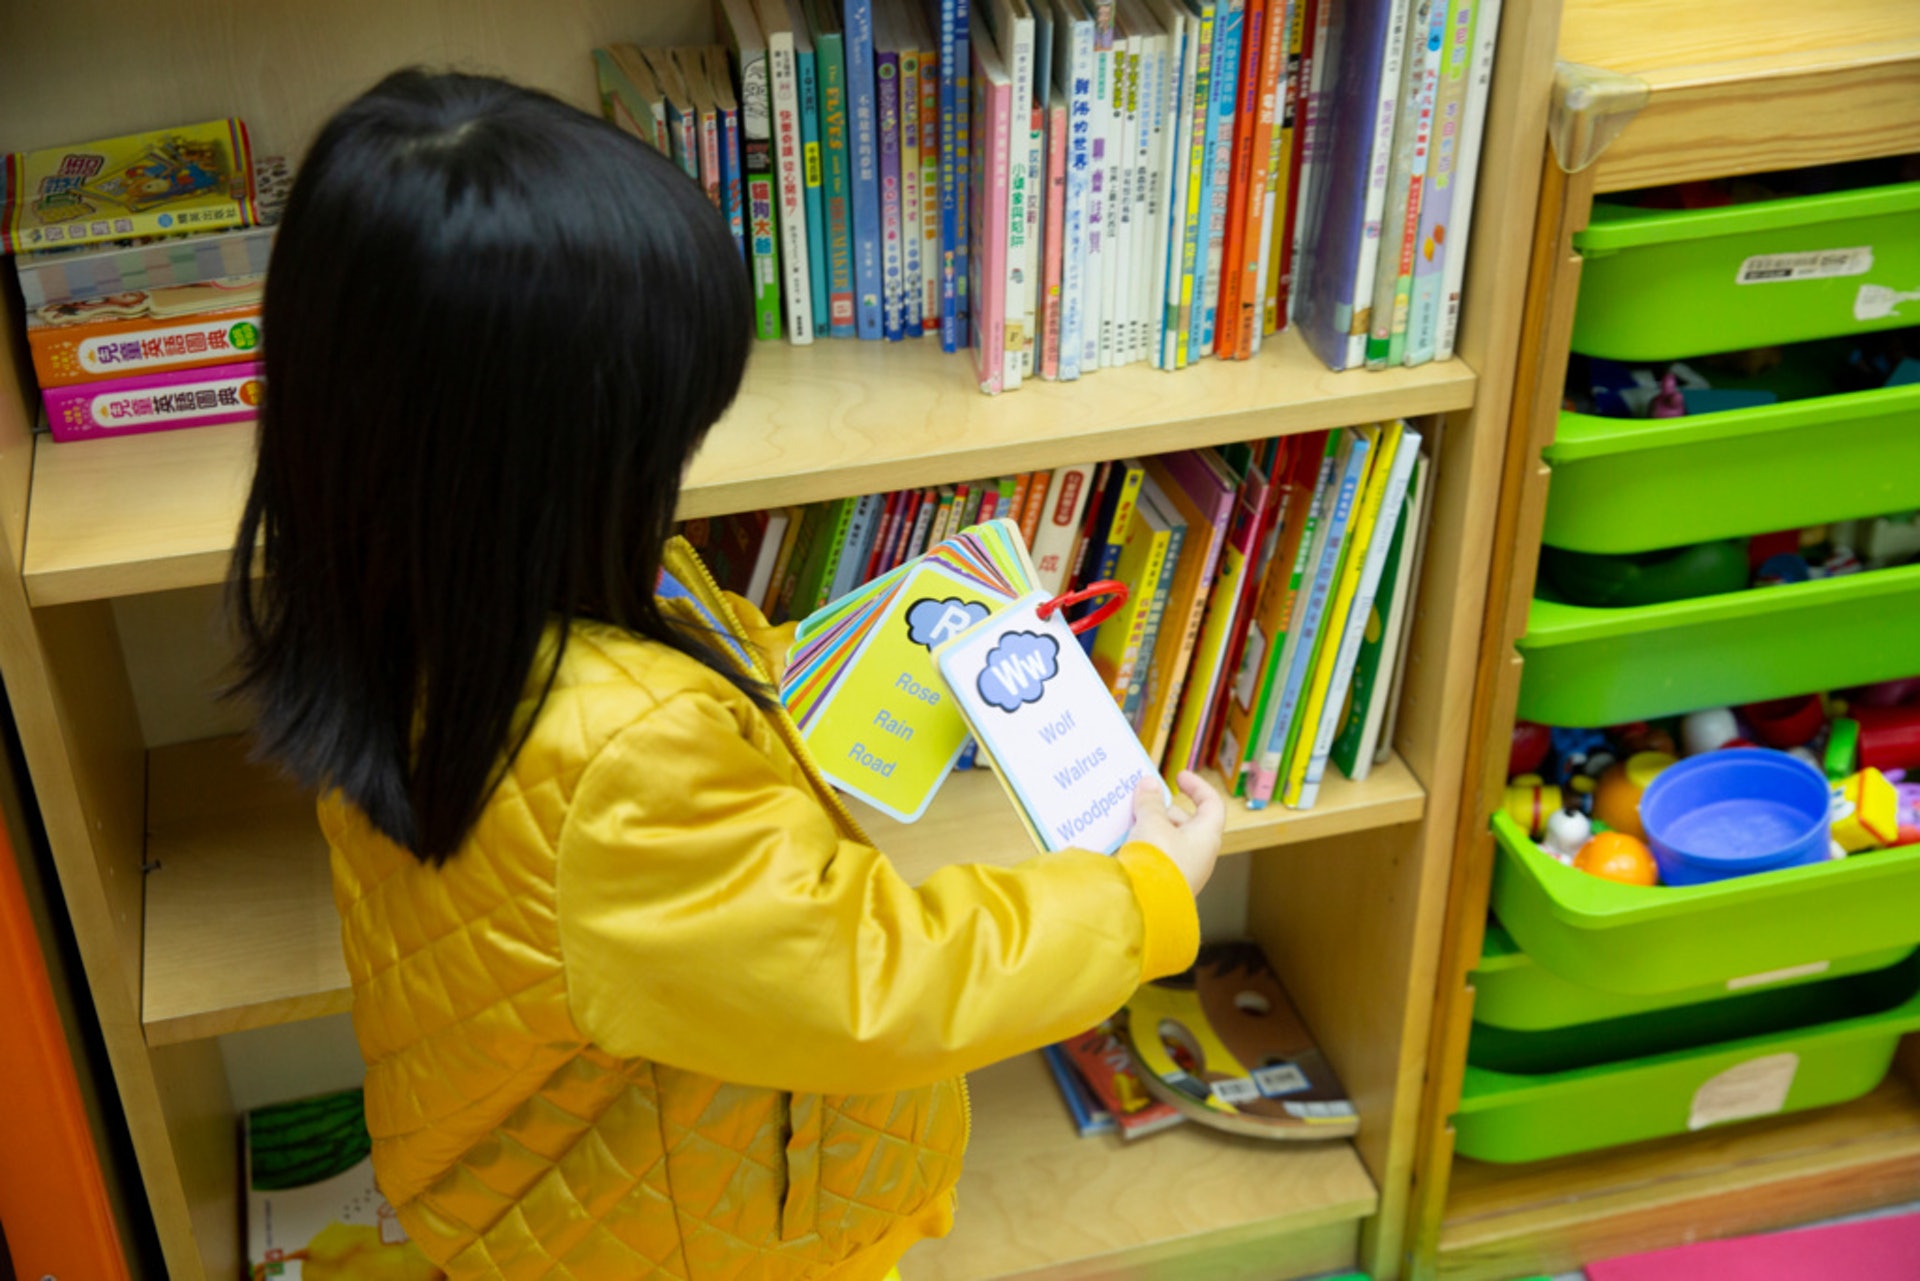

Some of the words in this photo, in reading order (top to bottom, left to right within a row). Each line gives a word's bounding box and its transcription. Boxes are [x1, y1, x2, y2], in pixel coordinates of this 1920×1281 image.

[826, 87, 845, 150] ELVES
[97, 329, 230, 365] 兒童英語圖典
[109, 386, 240, 419] 兒童英語圖典
[894, 672, 941, 706] Rose
[992, 650, 1047, 696] Ww
[873, 709, 914, 742] Rain
[1038, 709, 1076, 744] Wolf
[848, 742, 897, 778] Road
[1053, 747, 1107, 790] Walrus
[1056, 768, 1143, 842] Woodpecker
